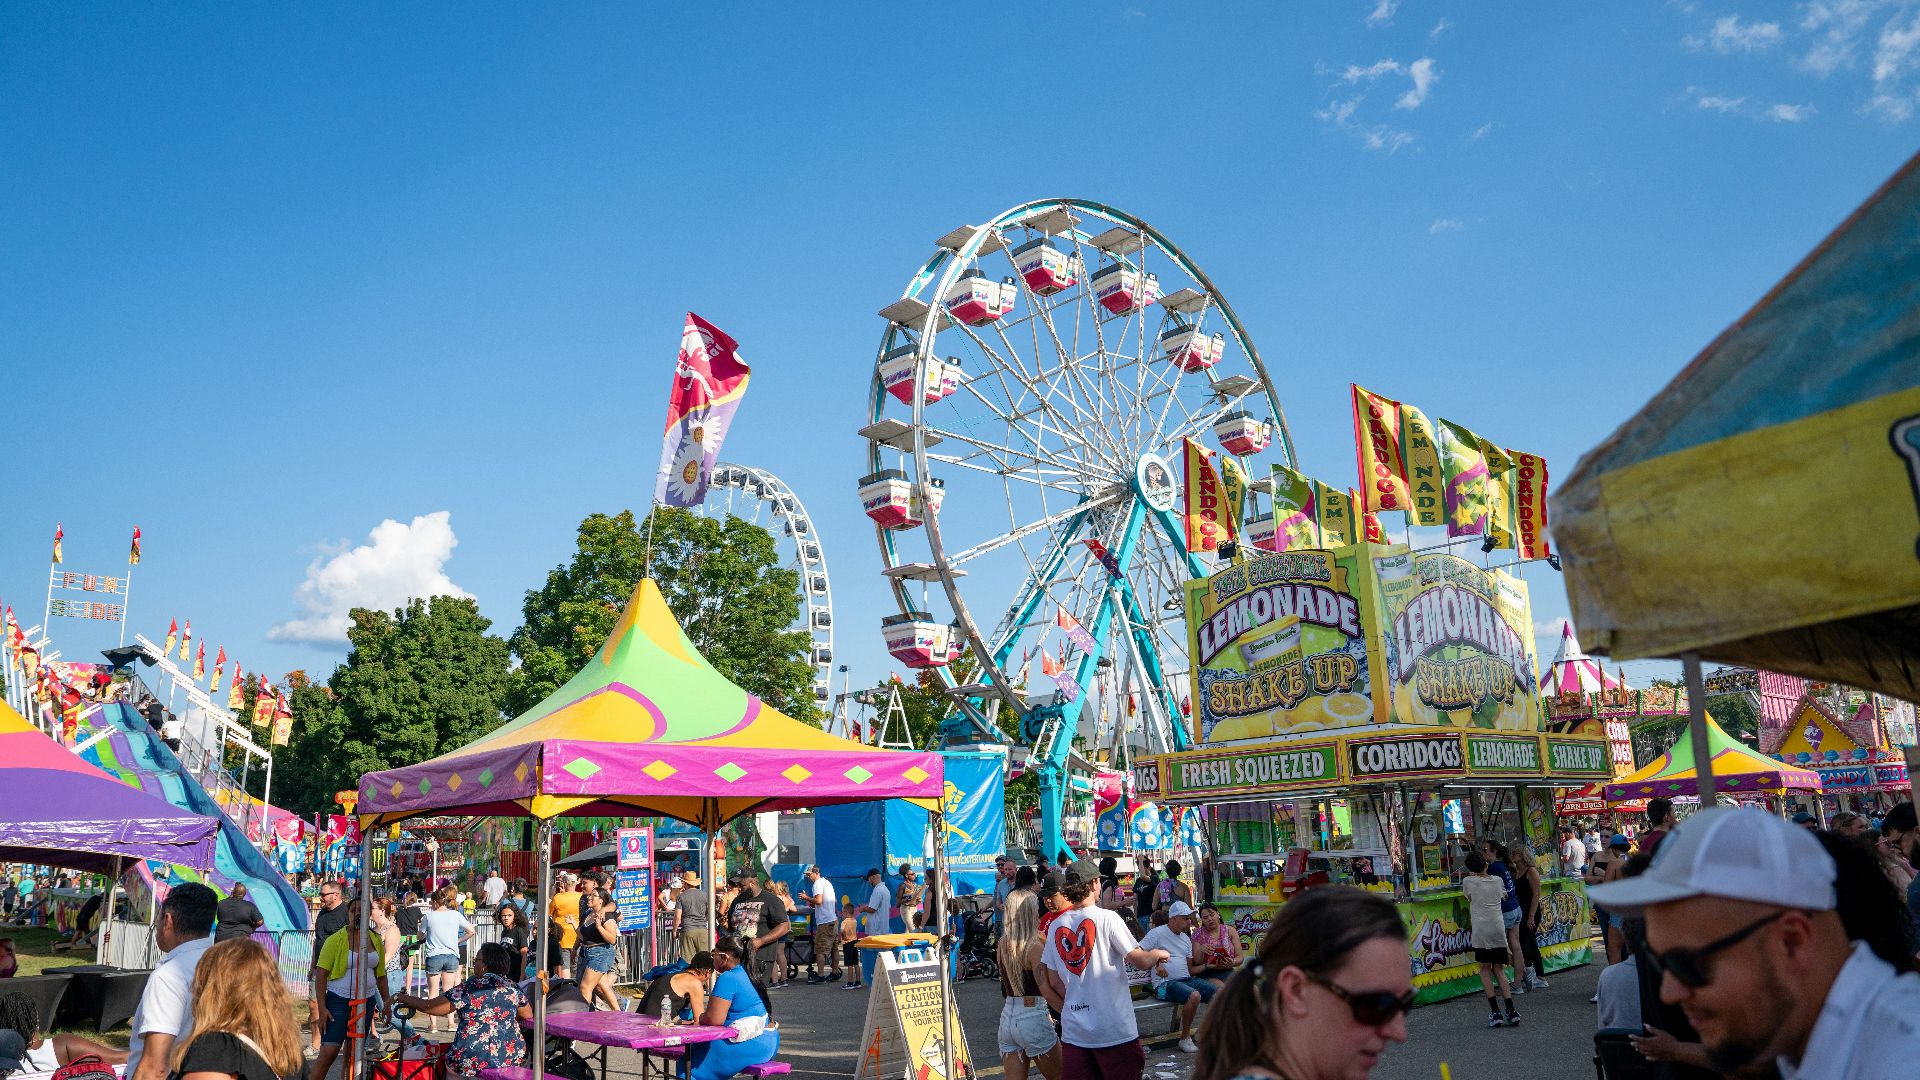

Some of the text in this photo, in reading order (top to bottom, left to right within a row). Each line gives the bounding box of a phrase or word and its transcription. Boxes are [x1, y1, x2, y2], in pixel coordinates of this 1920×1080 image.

[1410, 411, 1436, 523] LEMONADE
[1517, 454, 1536, 558] CORNDOGS
[63, 572, 117, 594] FUN
[51, 599, 121, 621] SLIDE
[1199, 584, 1360, 666] LEMONADE
[1210, 654, 1359, 716] SHAKE UP
[1417, 655, 1516, 712] SHAKE UP
[1181, 751, 1325, 789] FRESH SQUEEZED
[1357, 739, 1461, 773] CORNDOGS
[1473, 741, 1536, 768] LEMONADE
[1552, 744, 1602, 769] SHAKE UP
[630, 839, 638, 851] 9
[1423, 920, 1474, 968] Lemon
[904, 1007, 943, 1020] PLEASE WAT
[913, 1015, 944, 1027] YOUR STE
